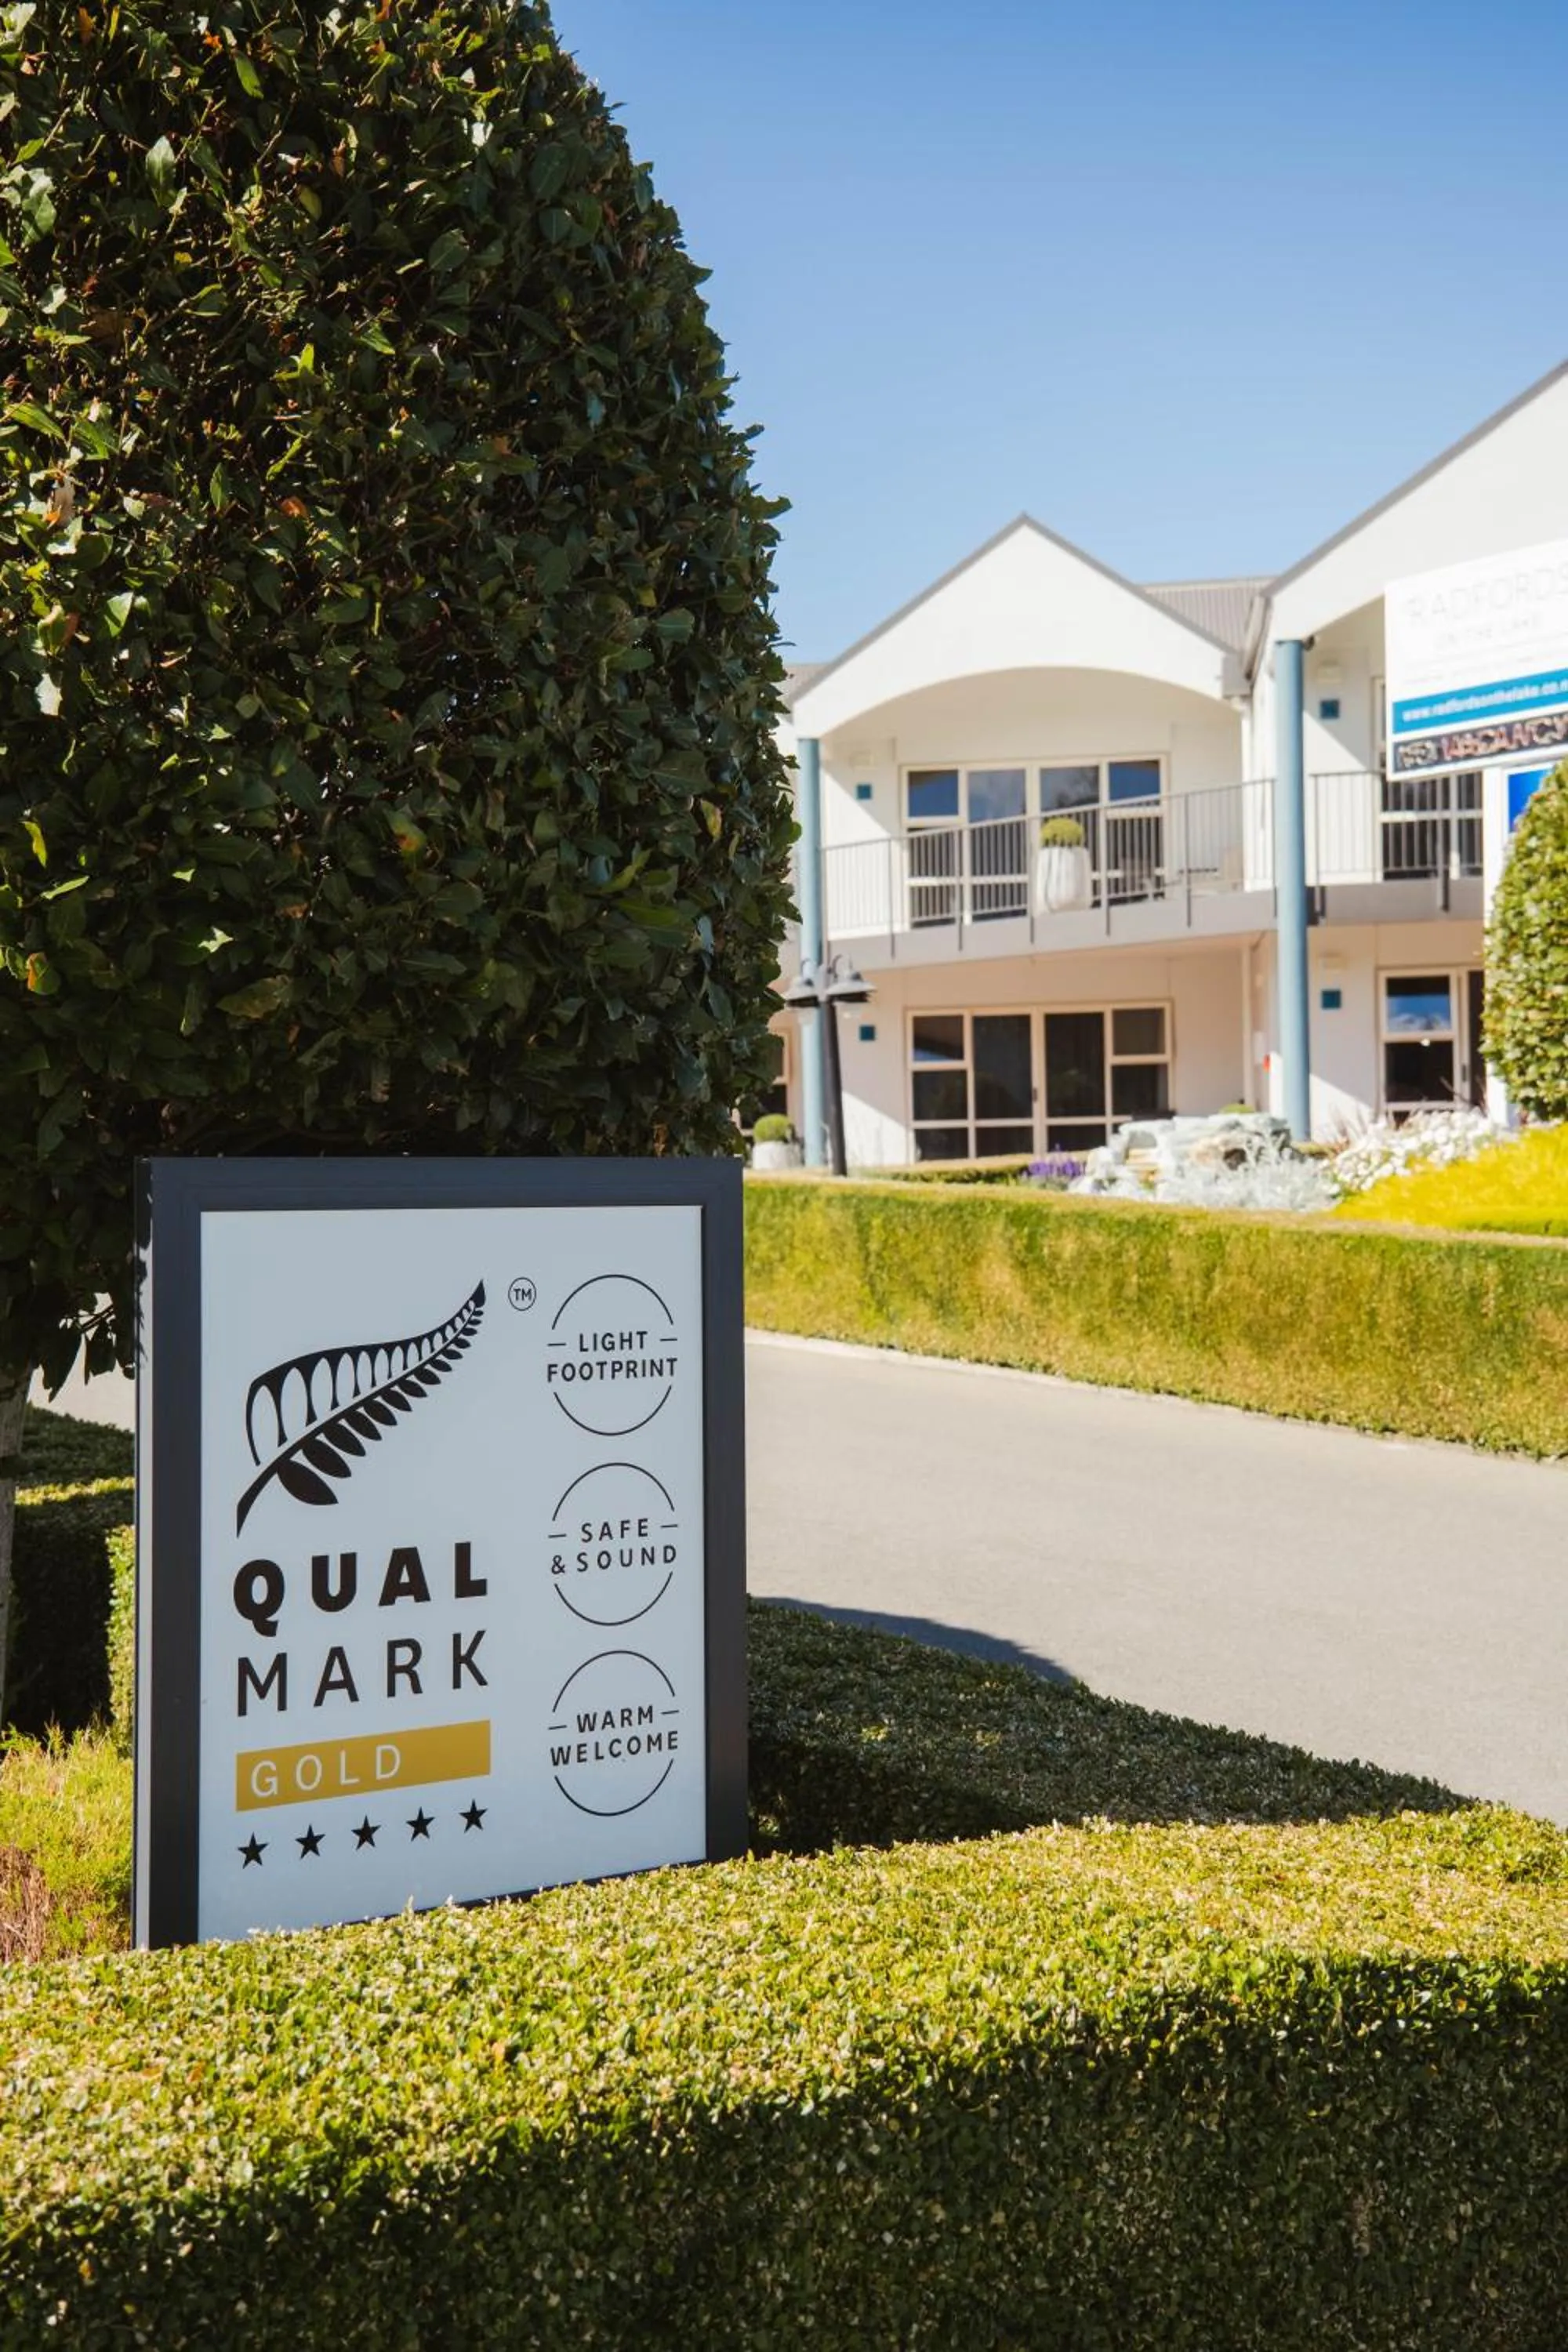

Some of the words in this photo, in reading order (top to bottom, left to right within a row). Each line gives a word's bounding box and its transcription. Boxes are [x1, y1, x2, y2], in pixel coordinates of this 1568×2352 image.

[514, 1287, 532, 1301] TM
[579, 1330, 648, 1352] LIGHT
[546, 1358, 678, 1383] FOOTPRINT
[580, 1518, 649, 1544] SAFE
[550, 1555, 566, 1575] &
[576, 1544, 677, 1573] SOUND
[234, 1541, 488, 1637] QUAL
[238, 1630, 488, 1717] MARK
[576, 1704, 654, 1733] WARM
[550, 1730, 679, 1767] WELCOME
[250, 1744, 401, 1797] GOLD
